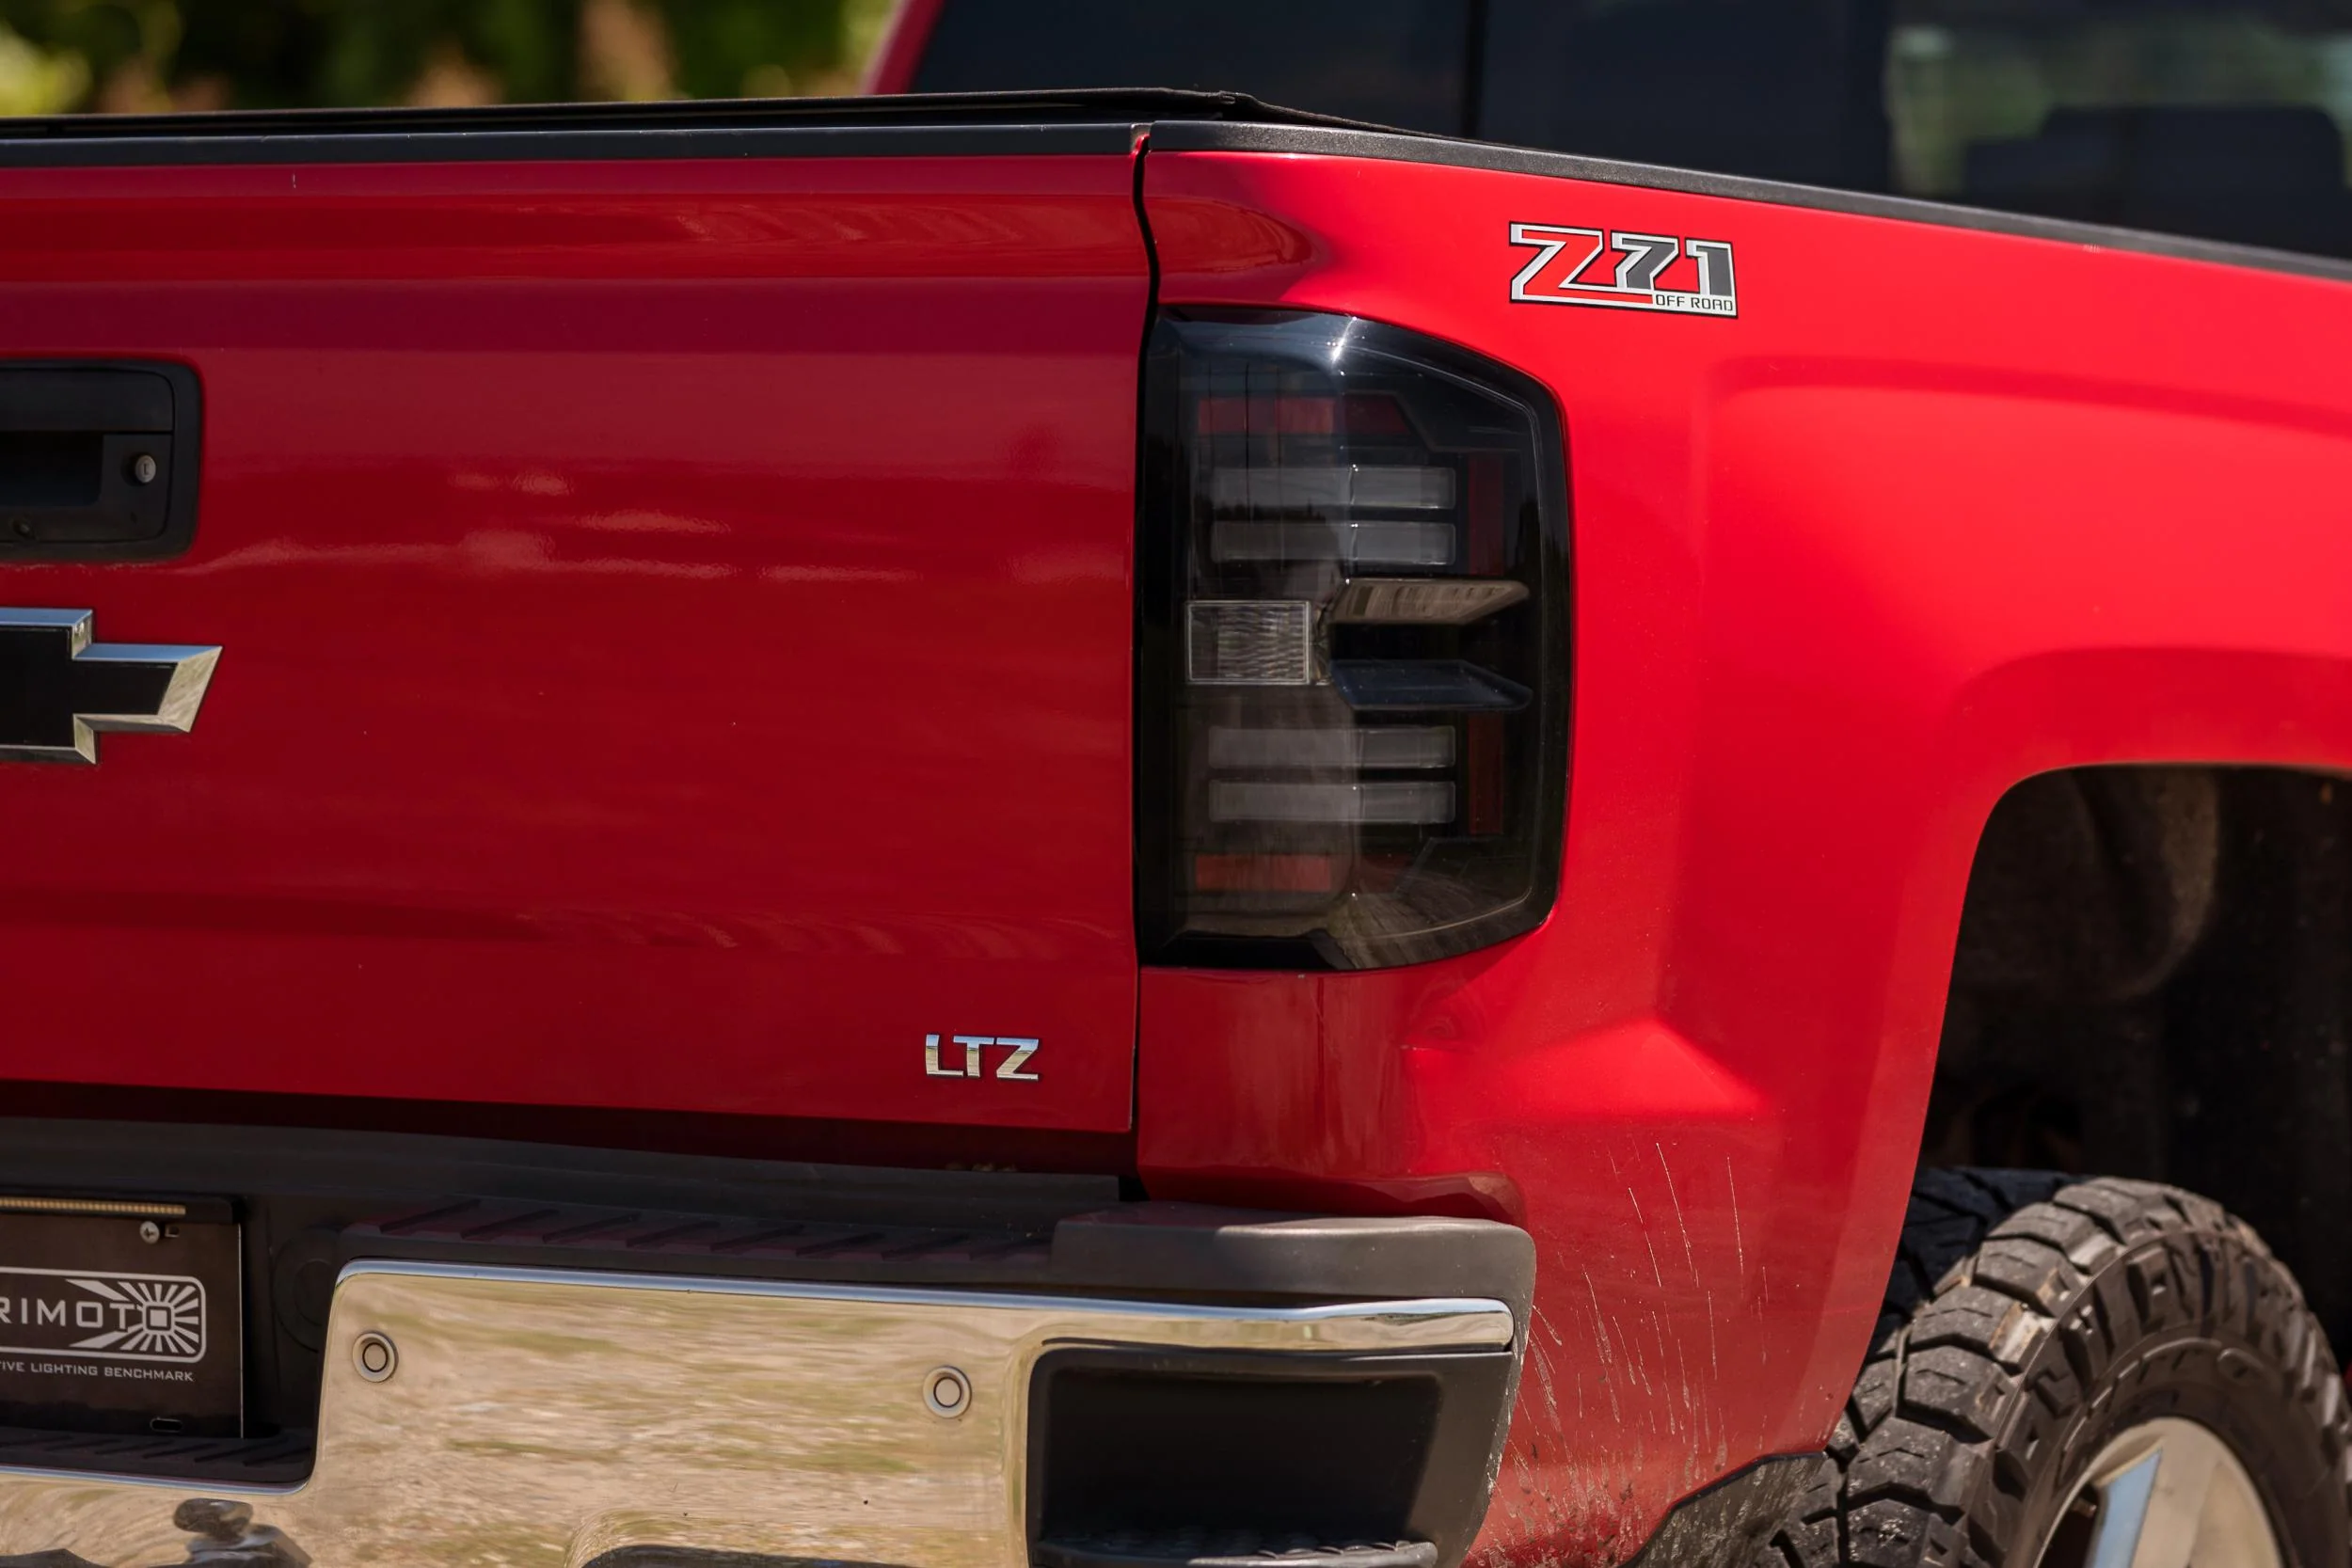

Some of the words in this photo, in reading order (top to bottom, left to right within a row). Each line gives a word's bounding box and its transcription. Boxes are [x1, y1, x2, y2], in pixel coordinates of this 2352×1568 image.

[1509, 221, 1737, 310] Z71
[1656, 294, 1685, 307] OFF
[1691, 297, 1733, 311] ROAD
[926, 1034, 1039, 1081] LTZ
[0, 1360, 25, 1372] IVE
[30, 1362, 98, 1377] LIGHTING
[104, 1367, 194, 1382] BENCHMARK
